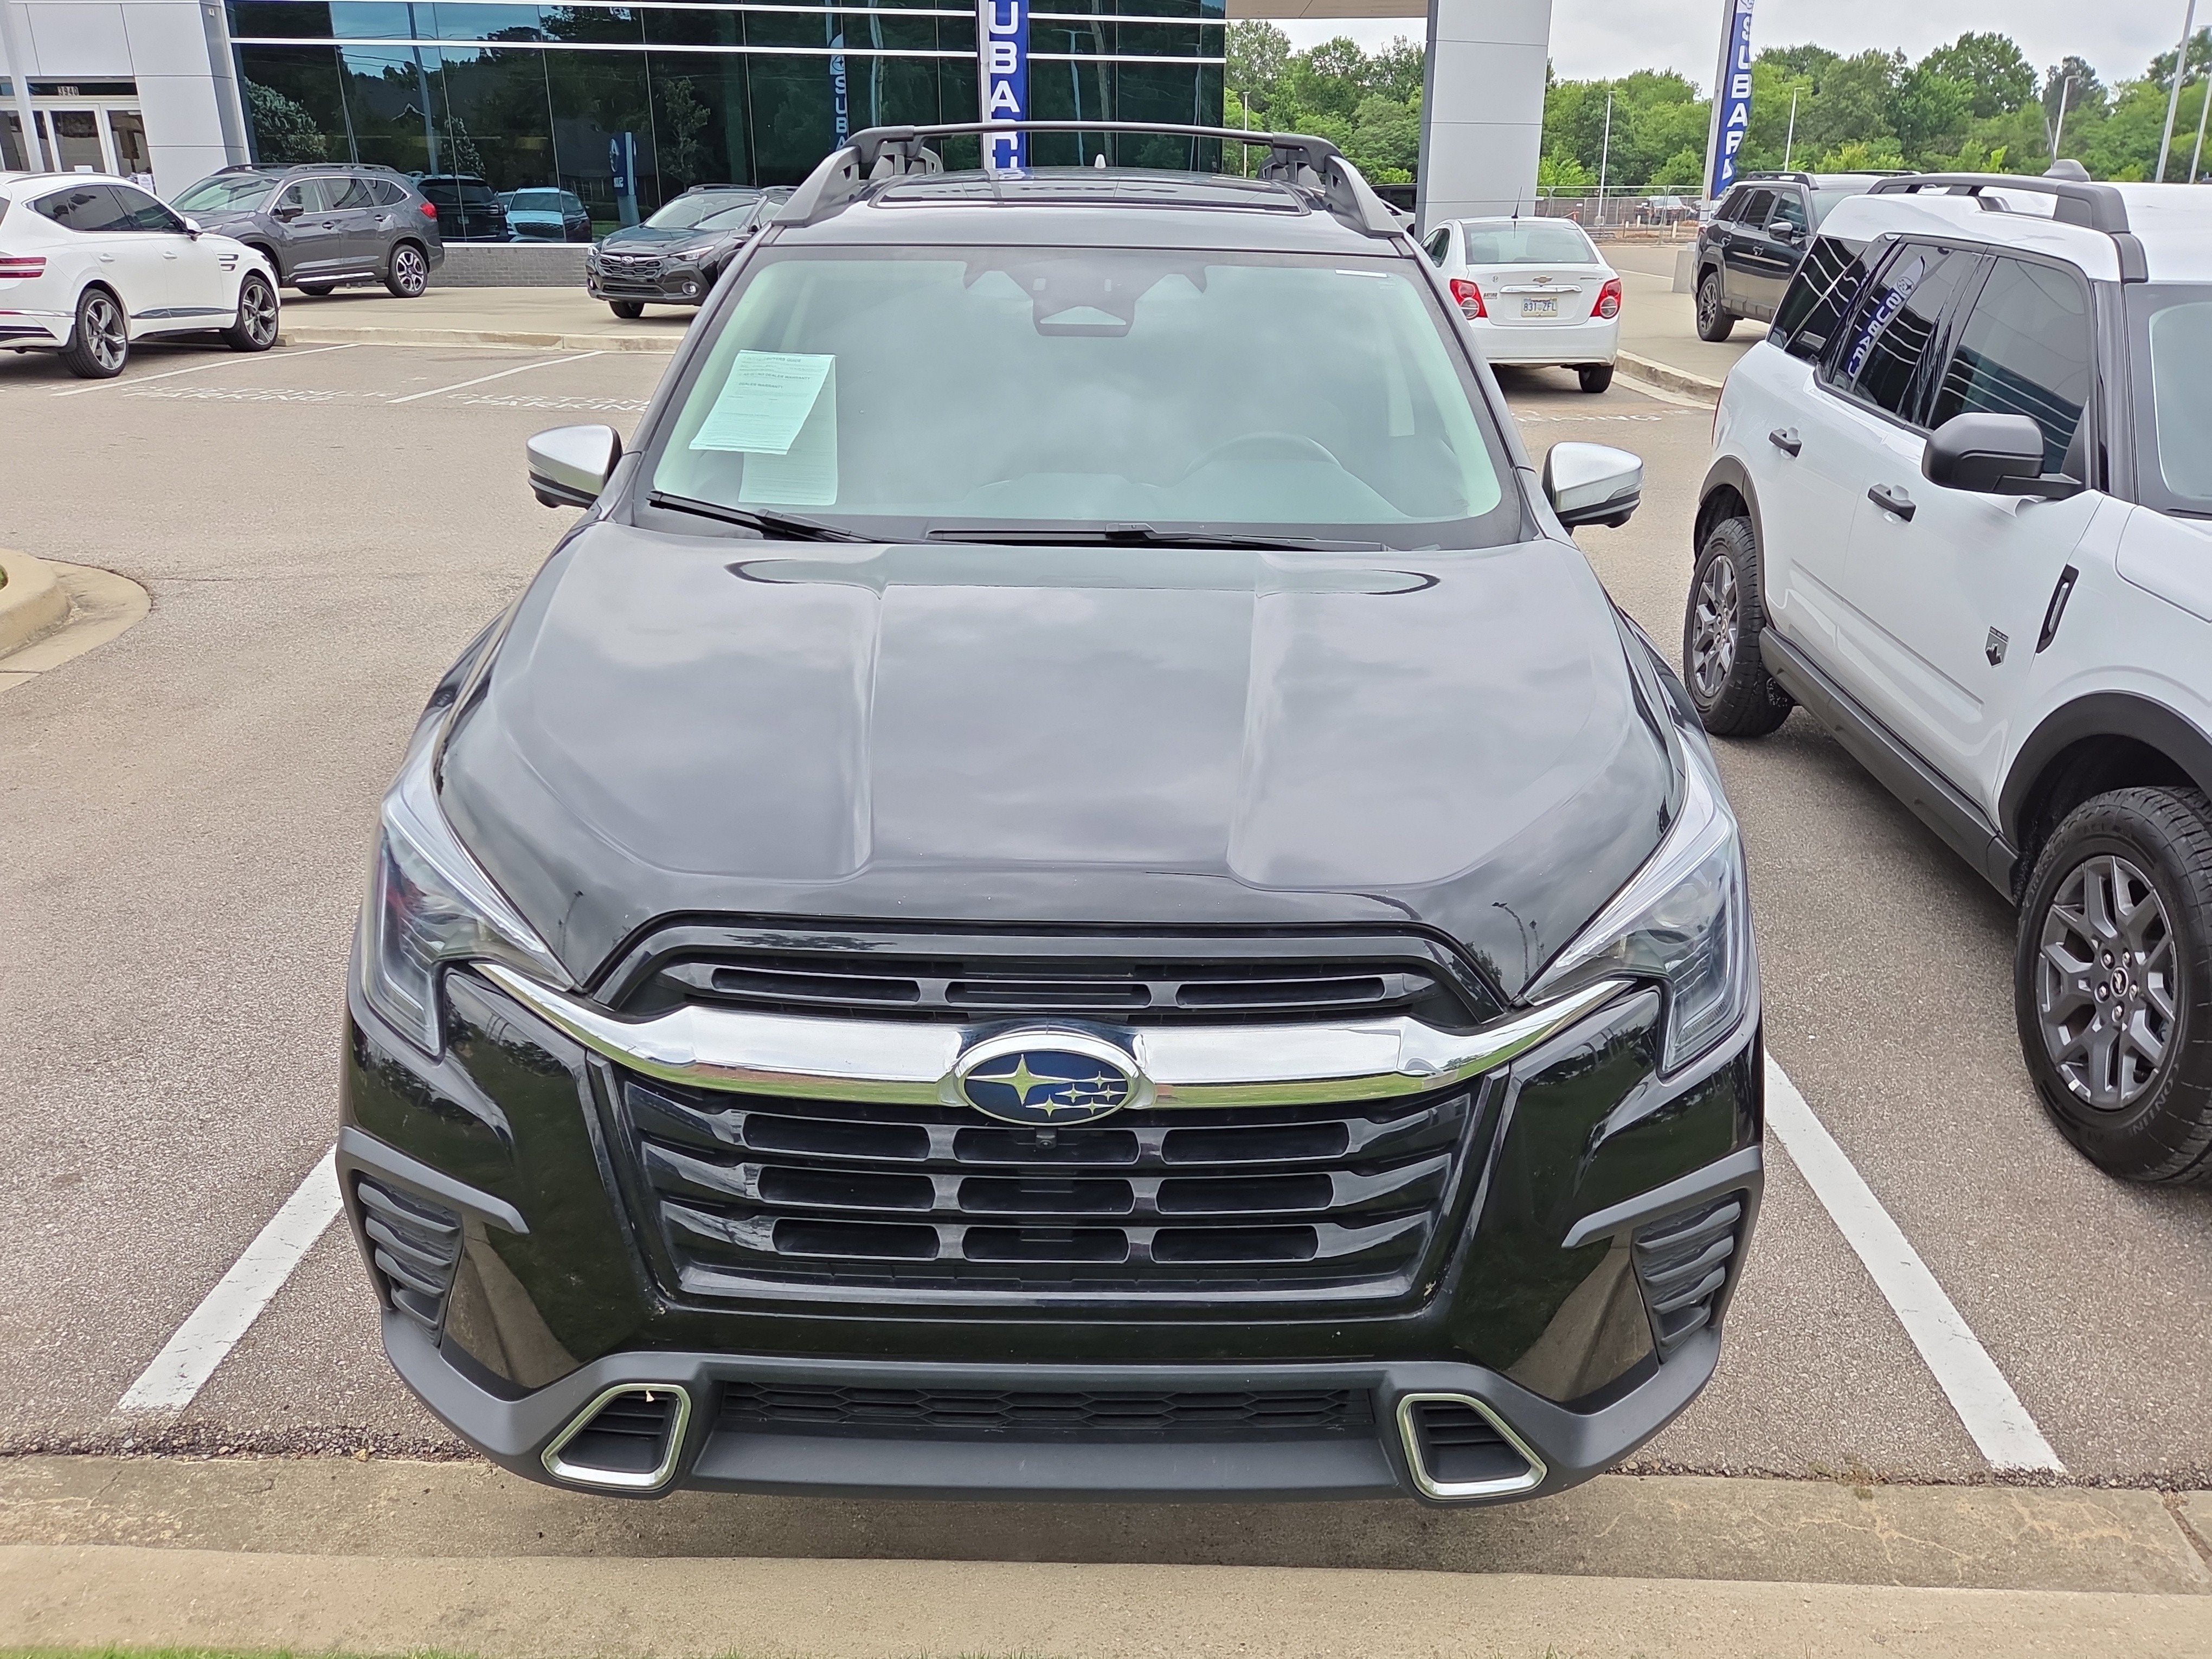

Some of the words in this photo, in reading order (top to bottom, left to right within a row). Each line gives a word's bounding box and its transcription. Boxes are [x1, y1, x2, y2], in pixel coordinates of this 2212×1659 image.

[57, 86, 79, 96] 3940
[1523, 303, 1536, 311] 831
[1542, 302, 1557, 311] ZFL
